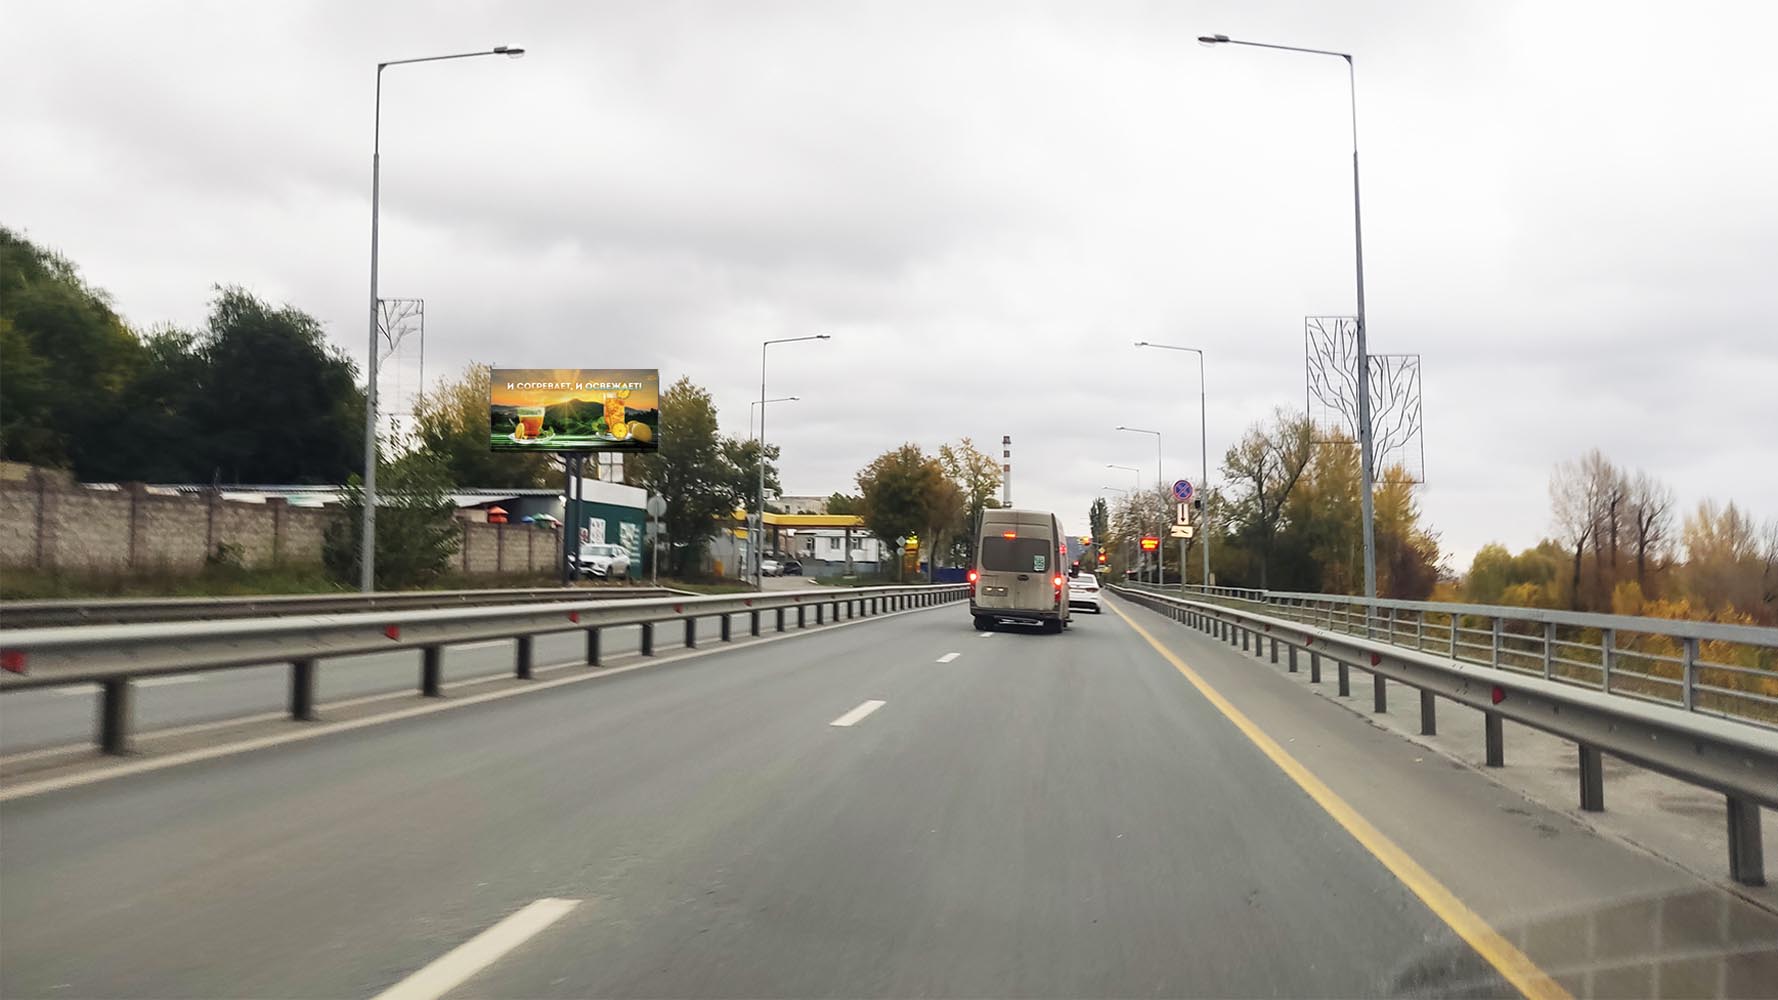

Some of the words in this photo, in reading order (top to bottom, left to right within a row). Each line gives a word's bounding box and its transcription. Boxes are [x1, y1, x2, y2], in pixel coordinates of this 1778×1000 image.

[507, 382, 514, 390] И
[575, 382, 583, 390] И
[585, 382, 642, 390] ОСВЕЖАЕТ!
